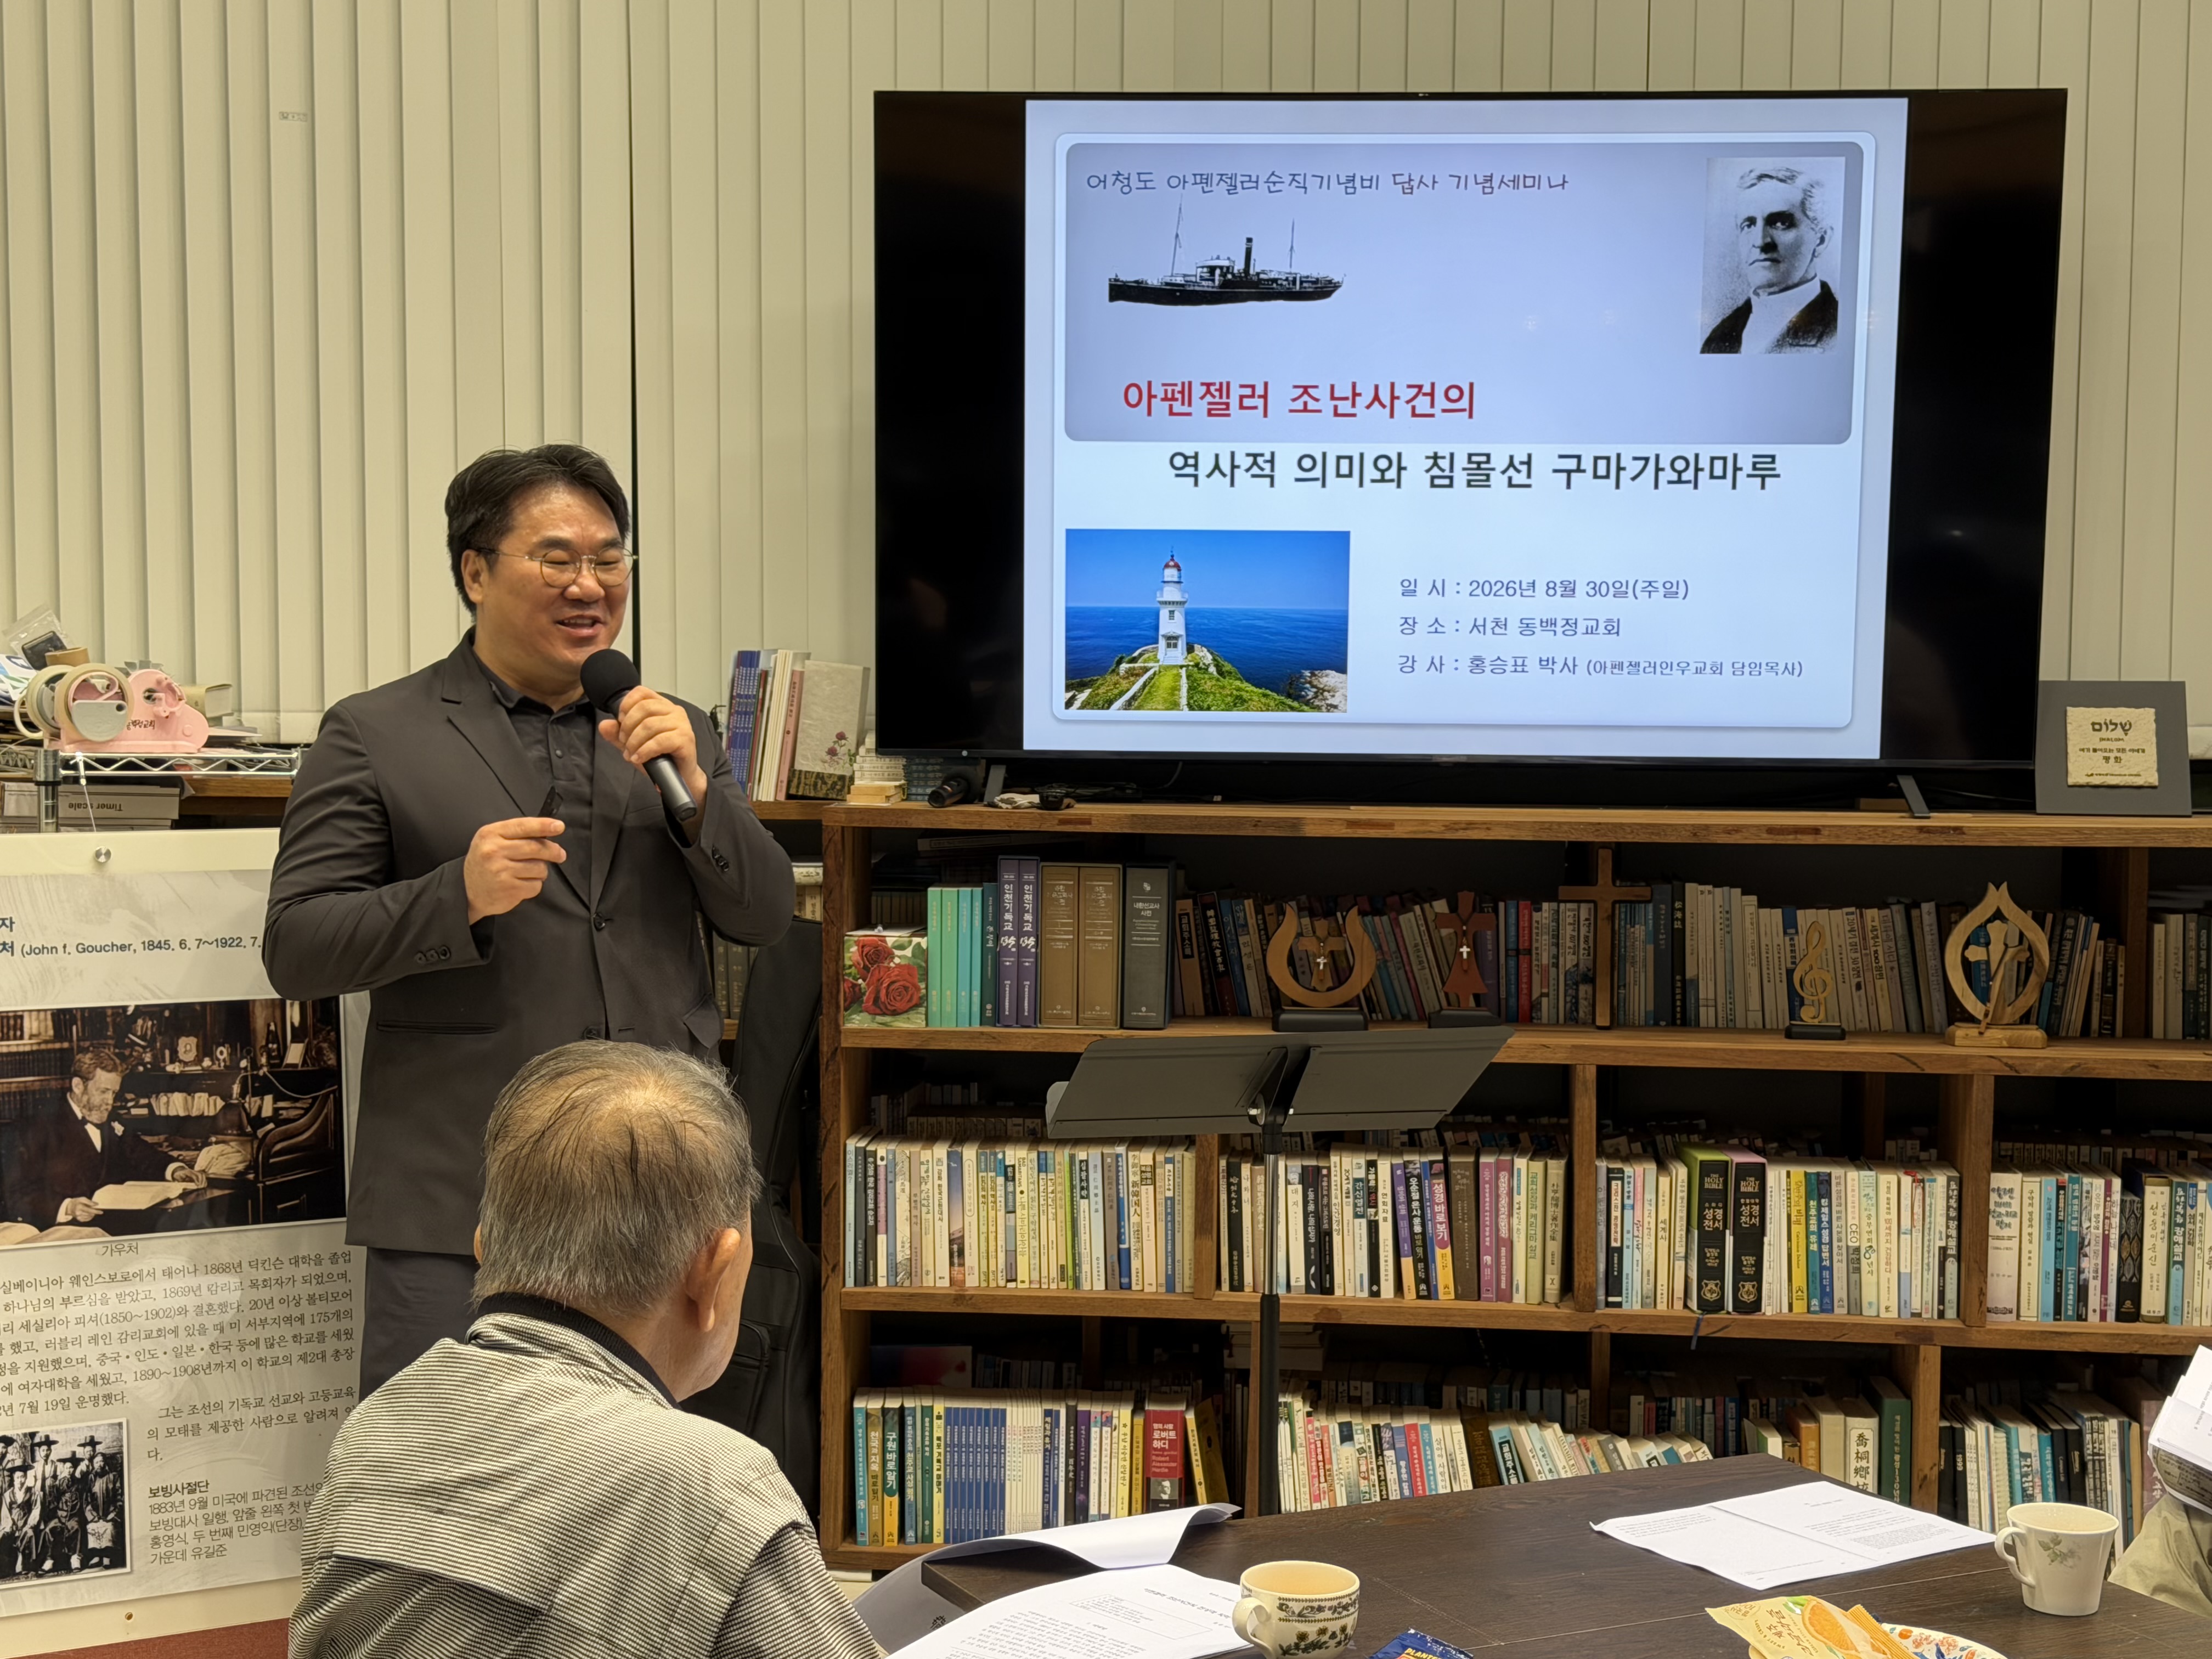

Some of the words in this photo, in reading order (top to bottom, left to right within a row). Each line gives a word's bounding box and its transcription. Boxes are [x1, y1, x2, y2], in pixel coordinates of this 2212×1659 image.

[1087, 171, 1156, 194] 어청도
[1167, 171, 1380, 195] 아펜젤러순직기념비
[1392, 172, 1438, 196] 답사
[1454, 172, 1569, 196] 기념세미나
[1123, 380, 1269, 419] 아펜젤러
[1288, 381, 1476, 420] 조난사건의
[1168, 451, 1277, 489] 역사적
[1294, 451, 1407, 489] 의미와
[1423, 451, 1535, 490] 침몰선
[1551, 451, 1782, 492] 구마가와마루
[1400, 578, 1418, 598] 일
[1427, 578, 1446, 599] 시
[1469, 579, 1537, 599] 2026년
[1545, 579, 1577, 599] 8월
[1585, 578, 1689, 600] 30일(주일)
[1400, 617, 1418, 636] 장
[1427, 618, 1446, 635] 소
[1469, 617, 1508, 636] 서천
[1517, 617, 1621, 637] 동백정교회
[1398, 655, 1417, 674] 강
[1426, 655, 1446, 674] 사
[1468, 654, 1529, 675] 홍승표
[1538, 656, 1578, 675] 박사
[1586, 659, 1723, 677] (아펜젤러인우교회
[1731, 659, 1802, 678] 담임목사)
[1003, 884, 1013, 931] 인천기독교
[1023, 884, 1033, 932] 인천기독교
[21, 944, 58, 958] (John
[76, 940, 137, 955] Goucher,
[141, 939, 175, 951] 1845.
[179, 938, 191, 951] 6.
[195, 936, 246, 950] 7~1922.
[1703, 1208, 1723, 1220] 성경
[1740, 1205, 1759, 1216] 성경
[1740, 1216, 1759, 1227] 전서
[1703, 1219, 1723, 1231] 전서
[1849, 1223, 1858, 1244] CEO
[101, 1242, 139, 1257] 가우처
[69, 1268, 156, 1288] 웨인스보로에서
[162, 1264, 199, 1280] 태어나
[204, 1260, 244, 1276] 1868년
[249, 1257, 285, 1272] 딕킨슨
[289, 1253, 324, 1269] 대학을
[328, 1250, 352, 1265] 졸업
[3, 1297, 54, 1314] 하나님의
[60, 1292, 111, 1310] 부르심을
[163, 1283, 202, 1300] 1869년
[207, 1280, 245, 1295] 감리교
[249, 1275, 297, 1291] 목회자가
[19, 1316, 71, 1334] 세실리아
[193, 1301, 244, 1317] 결혼했다.
[249, 1297, 274, 1311] 20년
[279, 1295, 303, 1308] 이상
[306, 1289, 353, 1306] 볼티모어
[45, 1335, 82, 1351] 러블리
[88, 1332, 112, 1347] 레인
[117, 1325, 179, 1344] 감리교회에
[185, 1323, 209, 1338] 있을
[213, 1321, 224, 1335] 때
[230, 1319, 241, 1333] 미
[246, 1313, 306, 1331] 서부지역에
[311, 1308, 353, 1324] 175개의
[236, 1337, 261, 1352] 등에
[264, 1335, 289, 1350] 많은
[291, 1330, 328, 1346] 학교를
[331, 1328, 354, 1341] 세웠
[18, 1375, 82, 1395] 여자대학을
[133, 1359, 236, 1383] 1890~1908년까지
[241, 1356, 253, 1370] 이
[257, 1353, 293, 1368] 학교의
[297, 1349, 328, 1365] 제2대
[330, 1346, 356, 1363] 총장
[19, 1400, 39, 1415] 7월
[44, 1397, 71, 1412] 19일
[75, 1391, 129, 1409] 운명했다.
[158, 1406, 184, 1420] 그는
[187, 1400, 224, 1417] 조선의
[229, 1396, 265, 1413] 기독교
[269, 1391, 306, 1408] 선교와
[308, 1386, 357, 1403] 고등교육
[147, 1427, 159, 1441] 의
[165, 1423, 202, 1438] 모태를
[207, 1418, 245, 1435] 제공한
[250, 1412, 298, 1429] 사람으로
[303, 1407, 338, 1424] 알려져
[1153, 1430, 1177, 1439] 로버트
[148, 1447, 163, 1462] 다.
[1153, 1440, 1169, 1449] 하디
[148, 1480, 210, 1499] 보빙사절단
[149, 1499, 185, 1515] 1883년
[189, 1496, 208, 1511] 9월
[213, 1491, 248, 1507] 미국에
[252, 1486, 288, 1502] 파견된
[149, 1514, 199, 1532] 보빙대사
[233, 1507, 258, 1523] 앞줄
[261, 1503, 285, 1519] 왼쪽
[288, 1500, 300, 1515] 첫
[193, 1530, 206, 1544] 두
[210, 1525, 234, 1541] 번째
[151, 1547, 188, 1566] 가운데
[191, 1543, 228, 1561] 유길준
